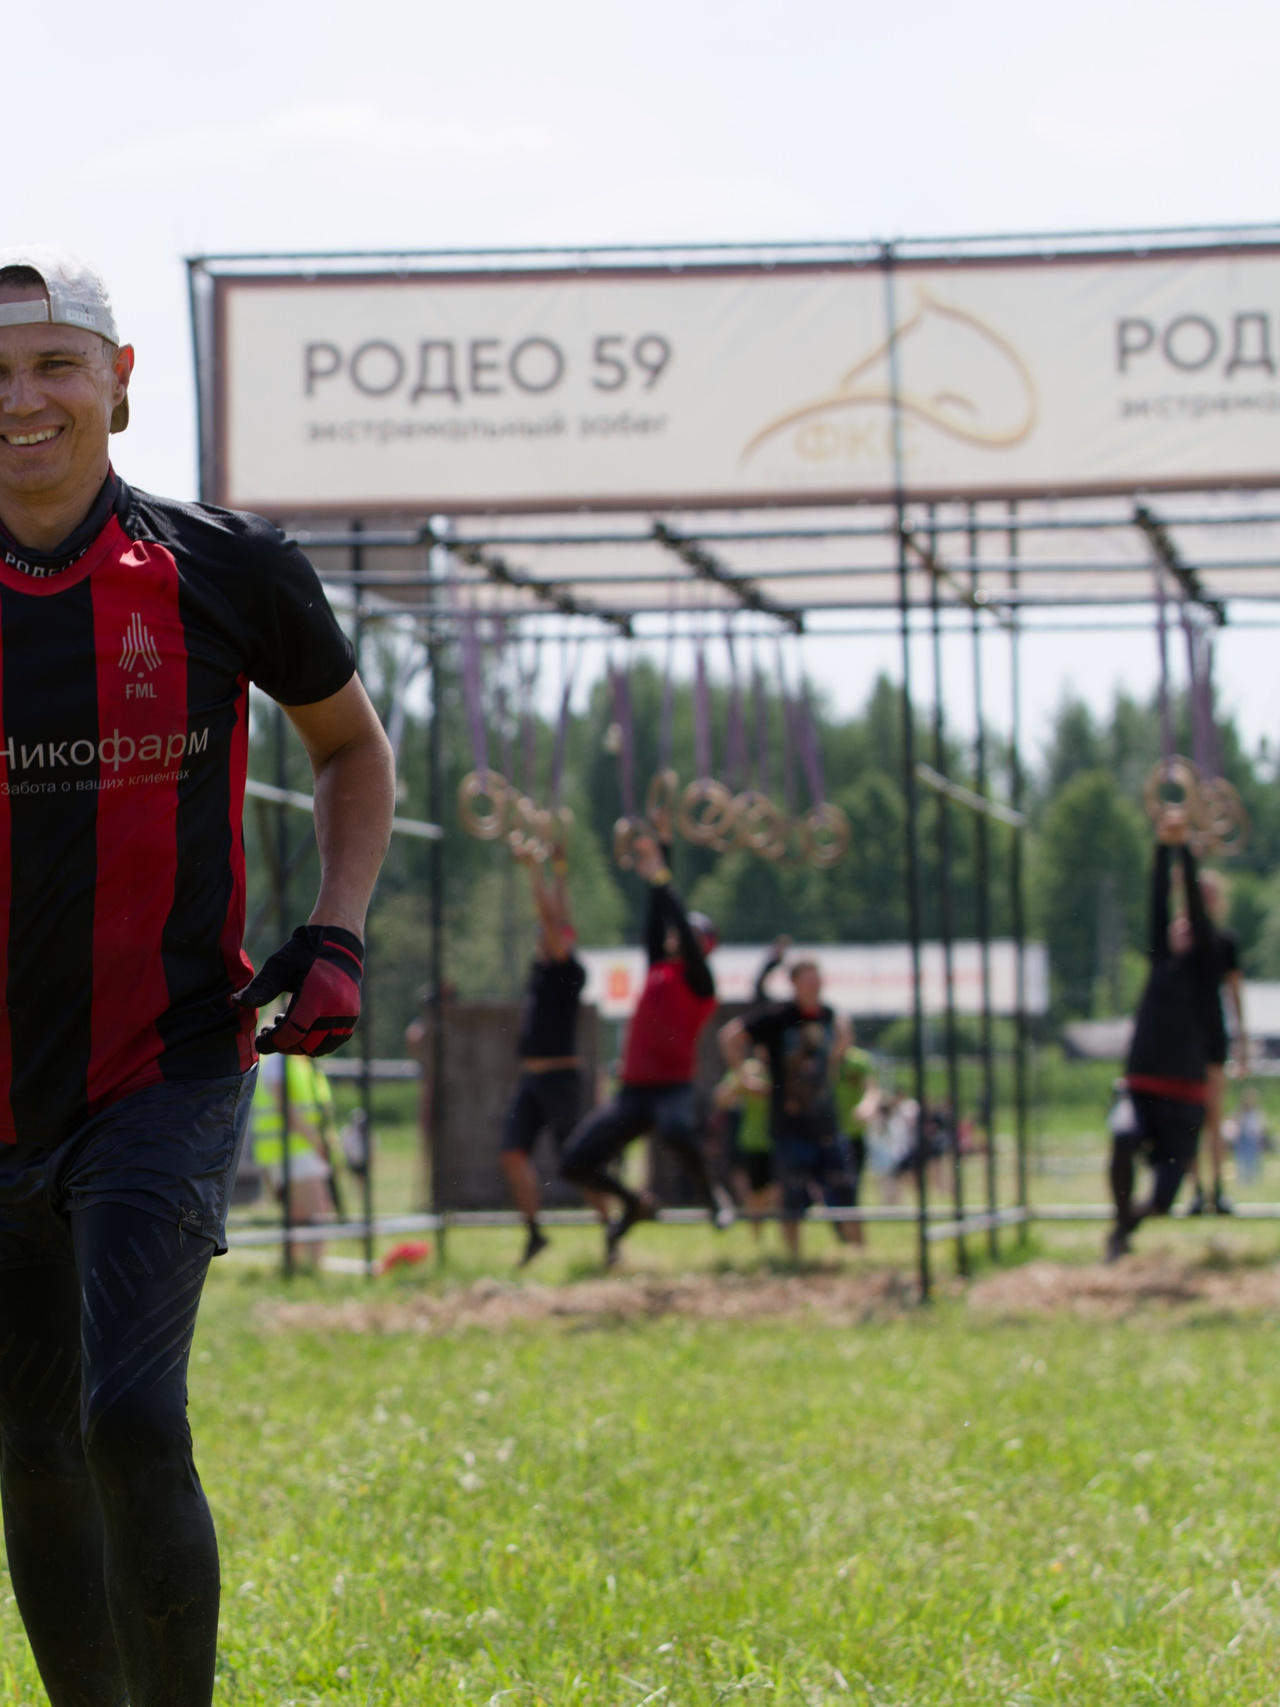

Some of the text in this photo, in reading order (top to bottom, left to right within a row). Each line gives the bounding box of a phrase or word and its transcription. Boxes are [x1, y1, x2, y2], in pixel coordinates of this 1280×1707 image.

[304, 333, 671, 405] РОДЕО 59
[125, 683, 158, 700] FML
[0, 768, 191, 796] Забота о ваших клиентах
